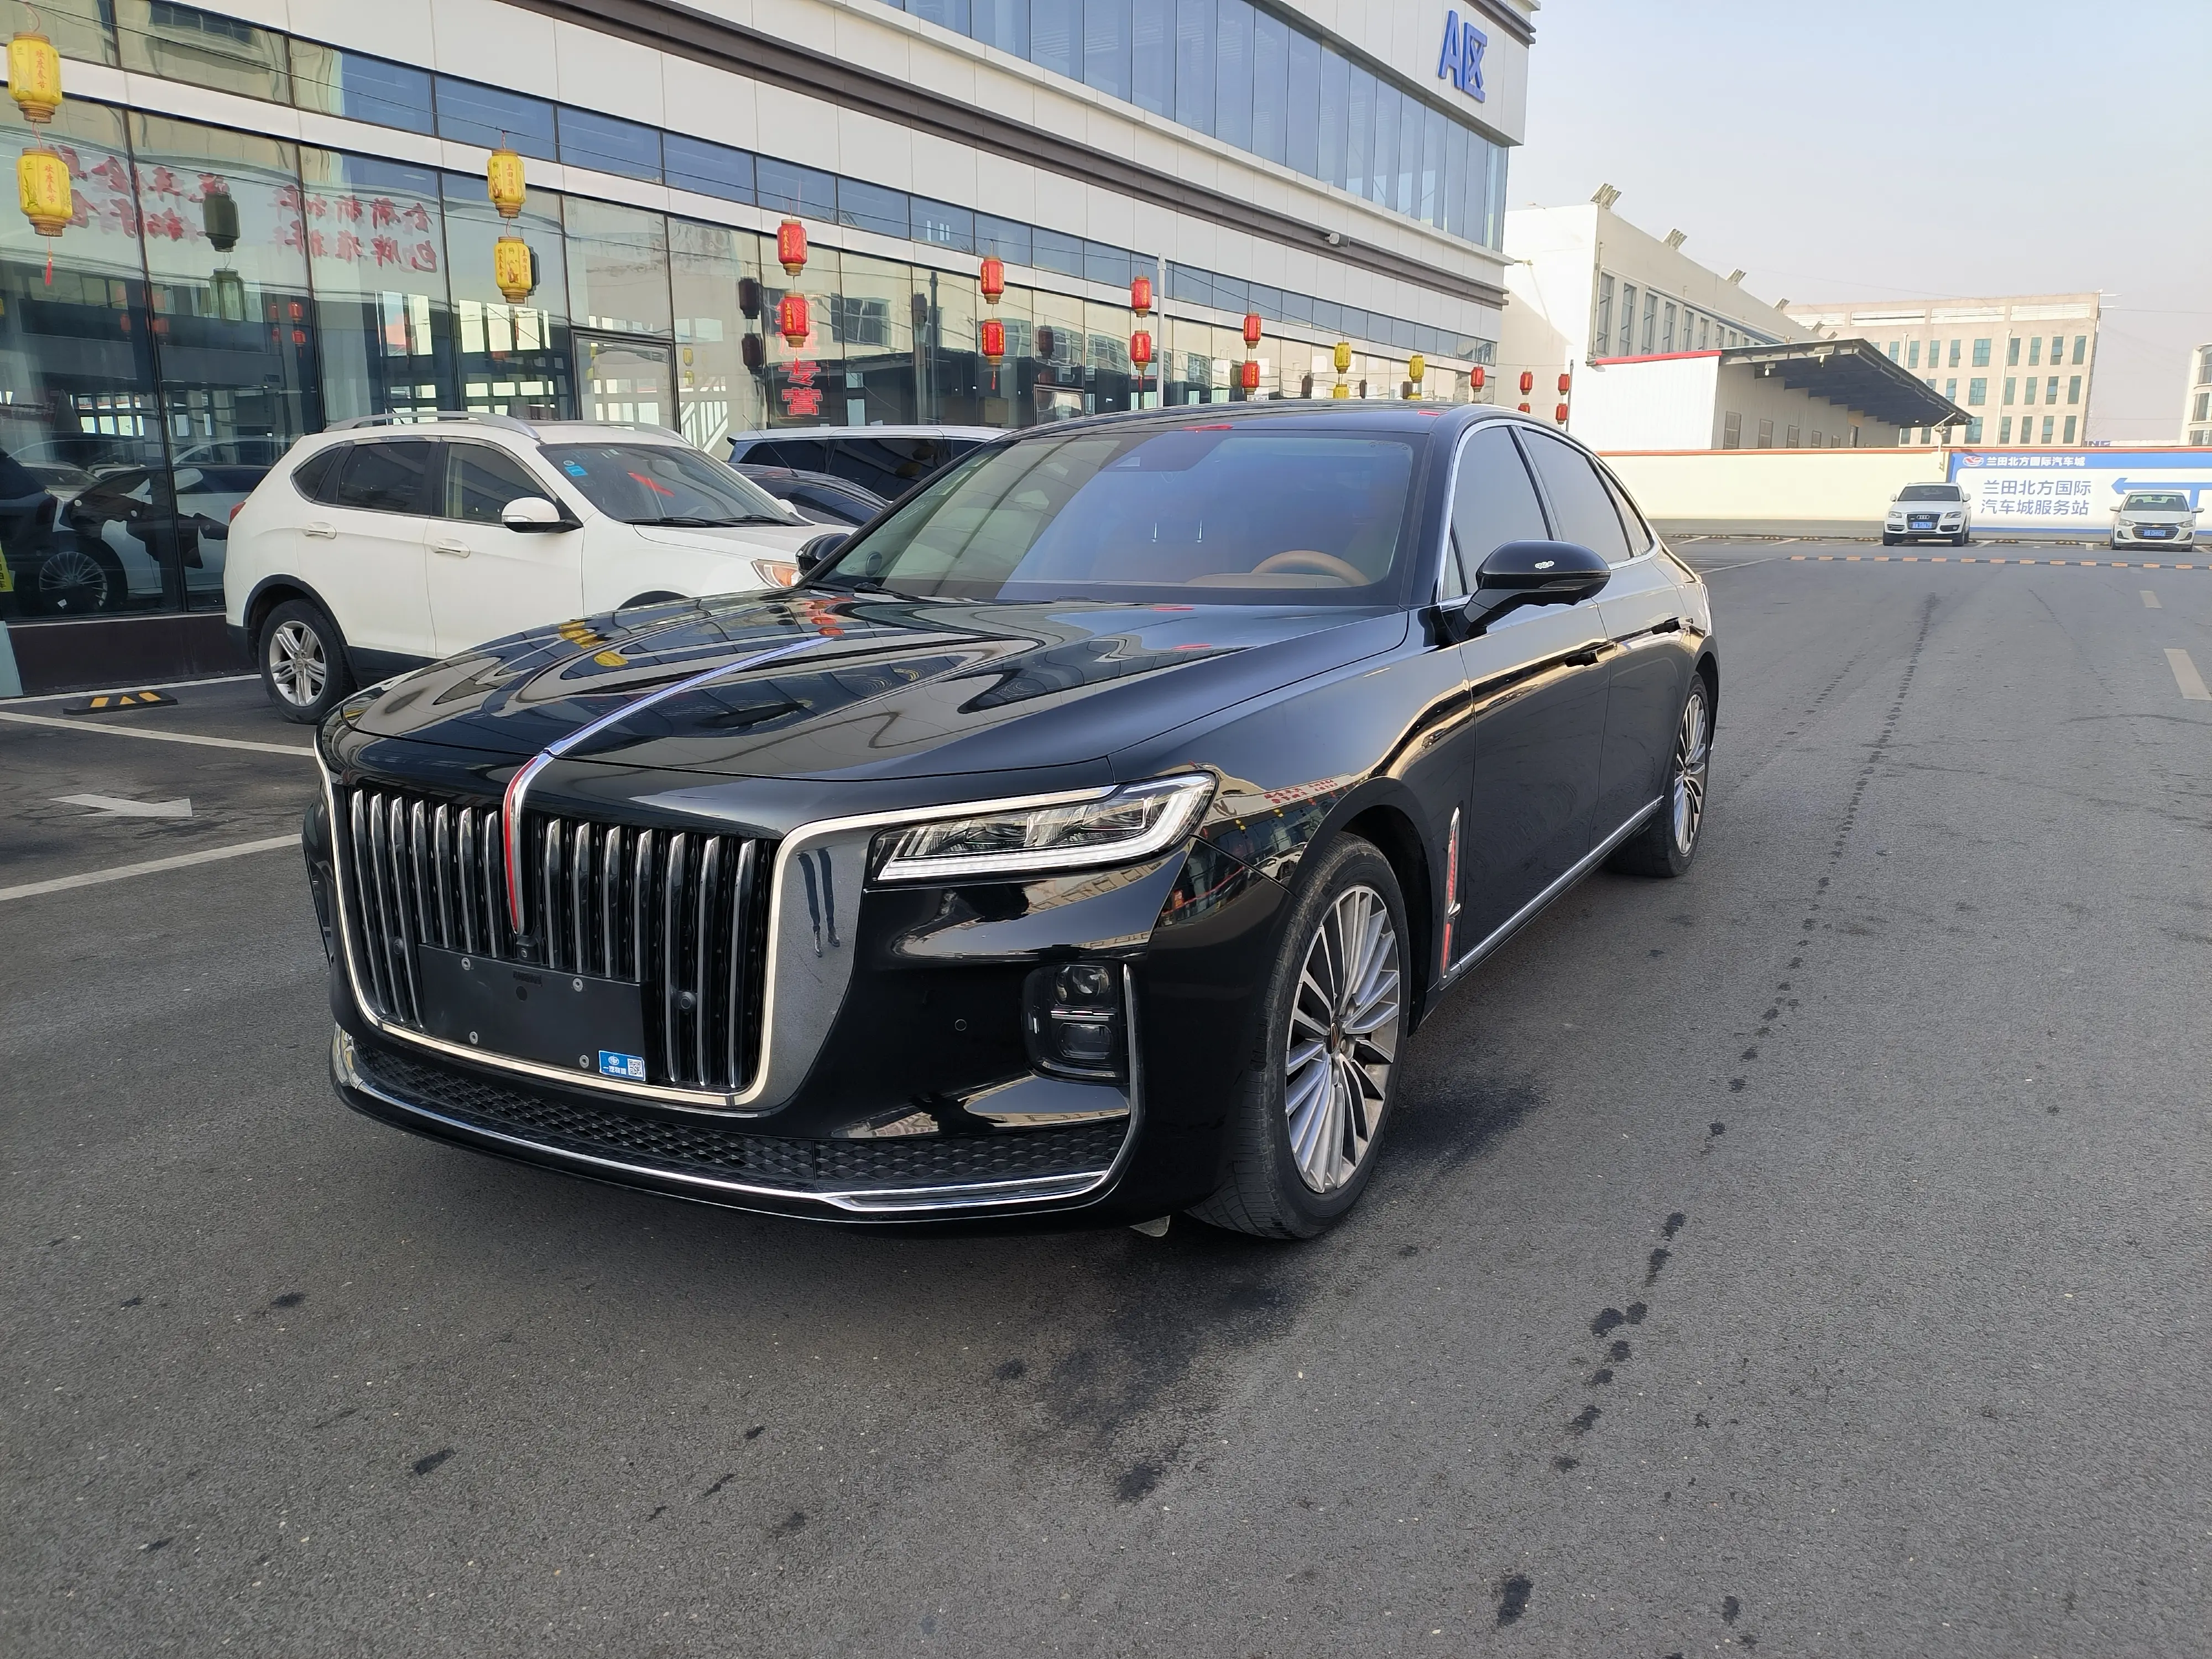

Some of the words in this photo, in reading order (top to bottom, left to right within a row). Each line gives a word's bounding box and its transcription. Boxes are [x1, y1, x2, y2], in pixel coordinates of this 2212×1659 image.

[35, 49, 47, 91] 欢度春节
[44, 164, 56, 205] 欢度春节
[1986, 456, 2086, 466] 兰田北方国际汽车城
[1983, 480, 2091, 495] 兰田北方国际
[1980, 499, 2090, 515] 汽车城服务站
